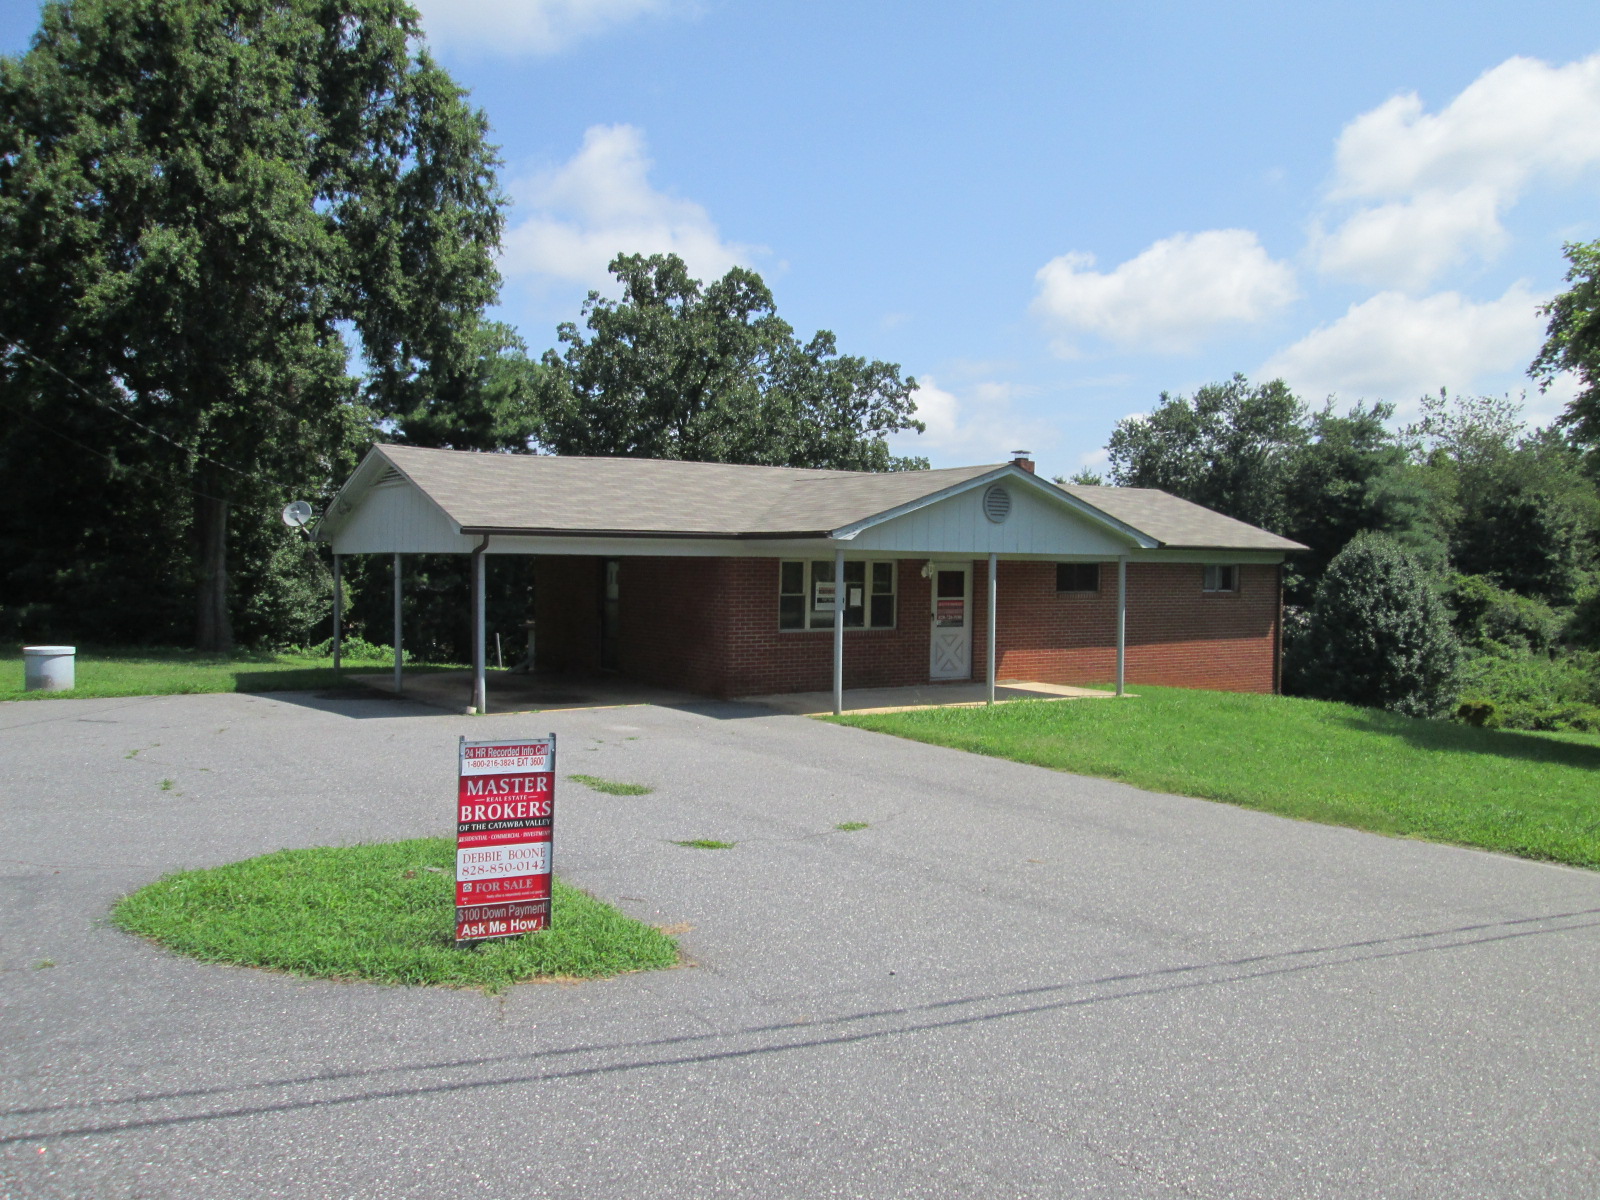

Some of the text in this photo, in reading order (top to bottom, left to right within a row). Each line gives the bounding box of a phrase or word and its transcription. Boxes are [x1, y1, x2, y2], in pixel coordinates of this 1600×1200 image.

[465, 744, 548, 758] 24 HR Recorded Info Call
[467, 757, 544, 768] 1-800-216-3824 EXT 3600
[467, 776, 548, 796] MASTER
[460, 800, 551, 822] BROKERS
[459, 824, 470, 832] OF
[488, 820, 524, 830] CATAWBA
[525, 818, 551, 826] VALLEY
[458, 834, 488, 842] RESIDENTIAL
[490, 832, 520, 840] COMMERCIAL
[463, 847, 546, 864] DEBBIE BOONE
[462, 860, 546, 876] 828-850-0142
[476, 878, 534, 892] FOR SALE
[458, 908, 480, 922] $100
[482, 906, 506, 920] Down
[462, 922, 486, 936] Ask
[489, 920, 507, 933] Me
